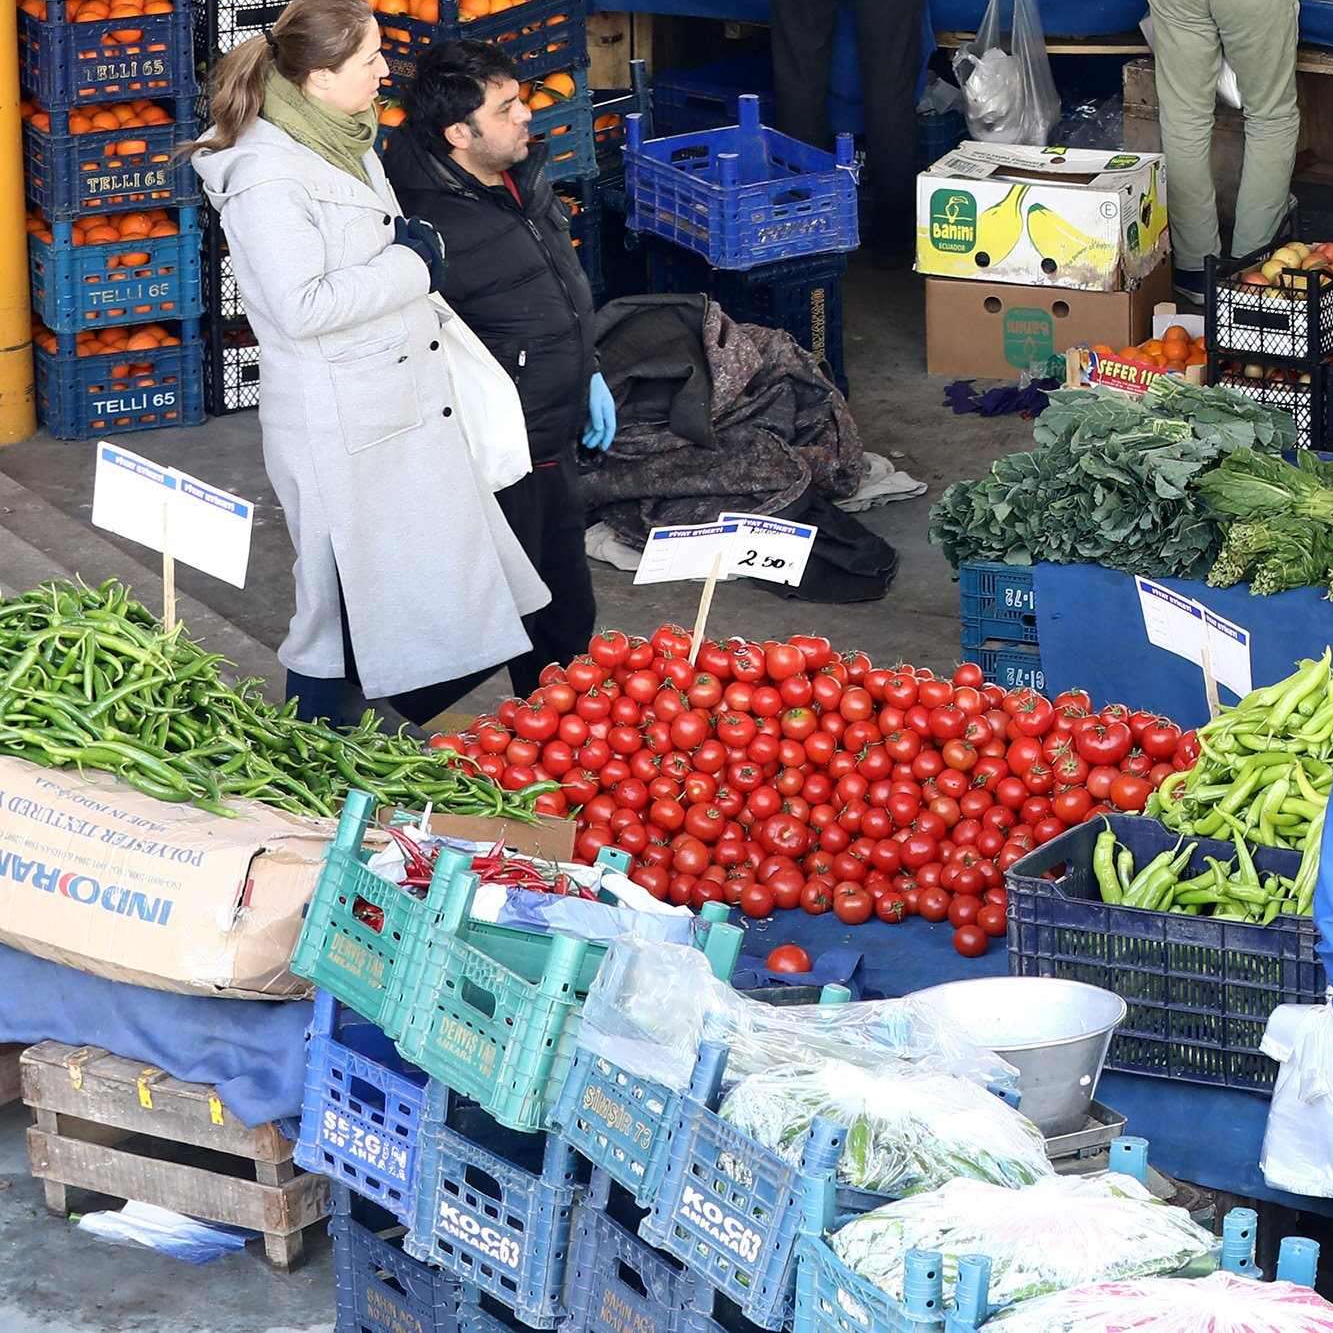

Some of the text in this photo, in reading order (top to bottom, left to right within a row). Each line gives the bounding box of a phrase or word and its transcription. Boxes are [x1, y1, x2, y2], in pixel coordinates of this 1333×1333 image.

[143, 60, 164, 75] 65
[145, 171, 166, 186] 65
[933, 222, 973, 242] Banini
[938, 242, 966, 252] ECUADOR
[89, 284, 169, 304] TELLİ 65
[1097, 359, 1138, 383] SEFER
[93, 392, 175, 414] TELLİ 65
[738, 549, 757, 566] 2
[8, 796, 100, 840] TEXTURED
[100, 828, 205, 867] POLYESTER
[440, 1220, 500, 1260] ANKARA
[680, 1205, 740, 1253] ANKARA
[500, 1237, 519, 1268] 63
[739, 1229, 762, 1262] 63
